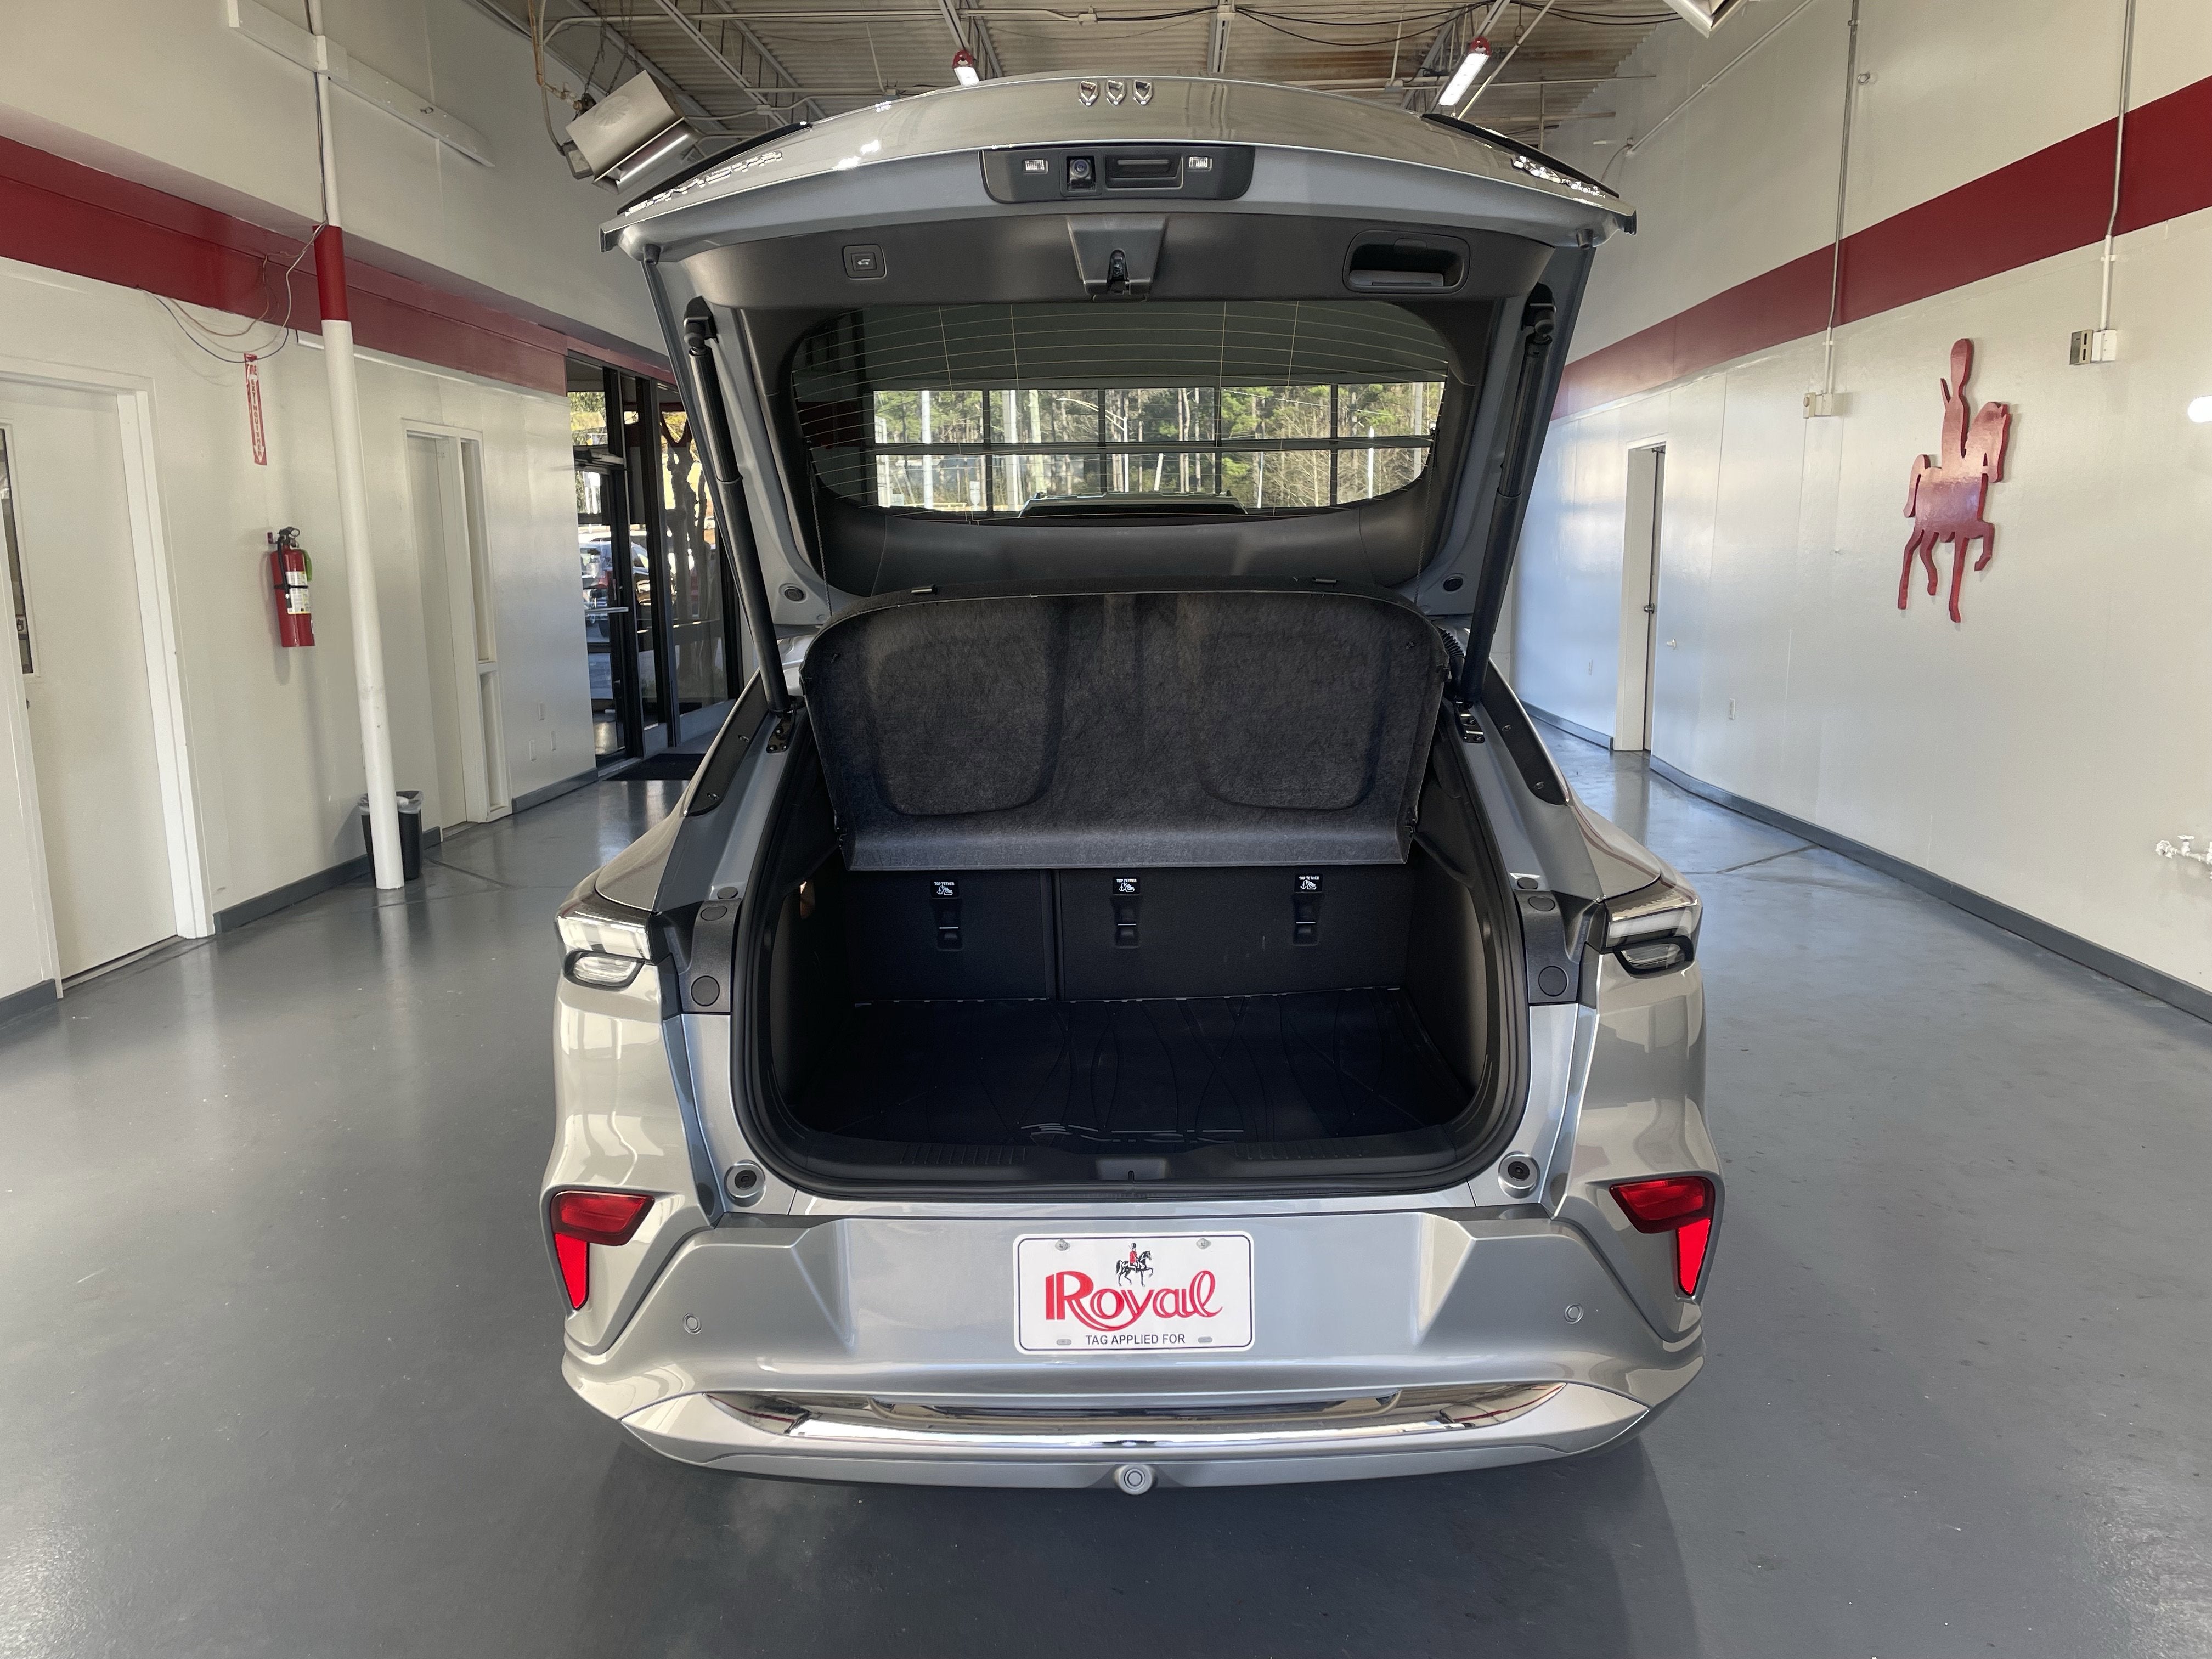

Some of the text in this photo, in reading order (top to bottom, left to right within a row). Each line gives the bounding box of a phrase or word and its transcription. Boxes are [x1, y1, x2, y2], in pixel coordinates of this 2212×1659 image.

[1046, 1270, 1223, 1332] Royal
[1085, 1334, 1186, 1345] TAG APPLIED FOR
